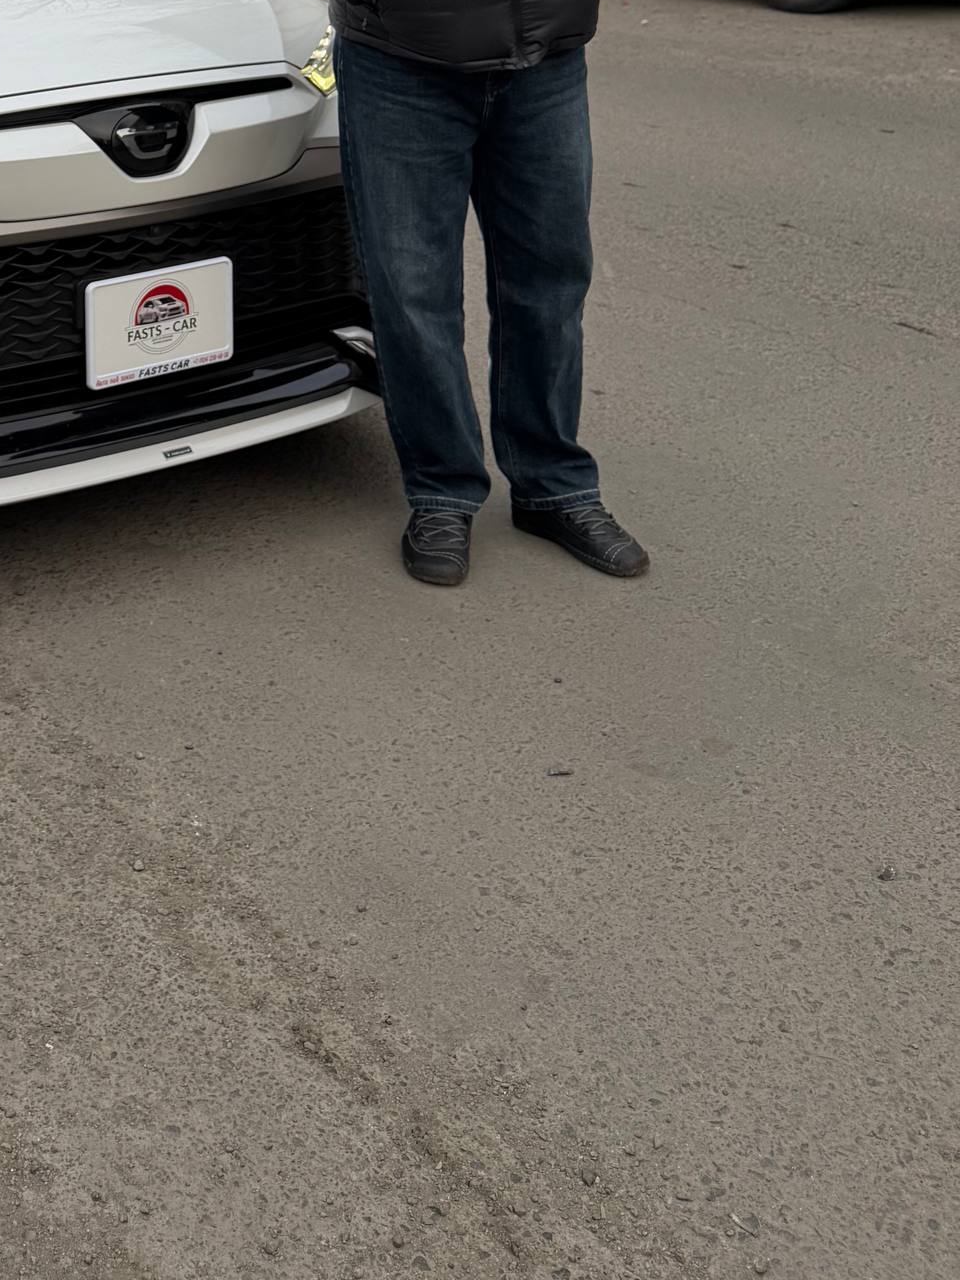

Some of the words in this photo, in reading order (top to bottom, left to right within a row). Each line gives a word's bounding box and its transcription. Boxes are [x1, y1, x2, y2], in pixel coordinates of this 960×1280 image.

[127, 325, 162, 343] FASTS
[173, 317, 197, 332] CAR
[138, 363, 169, 378] FASTS
[170, 359, 190, 371] CAR
